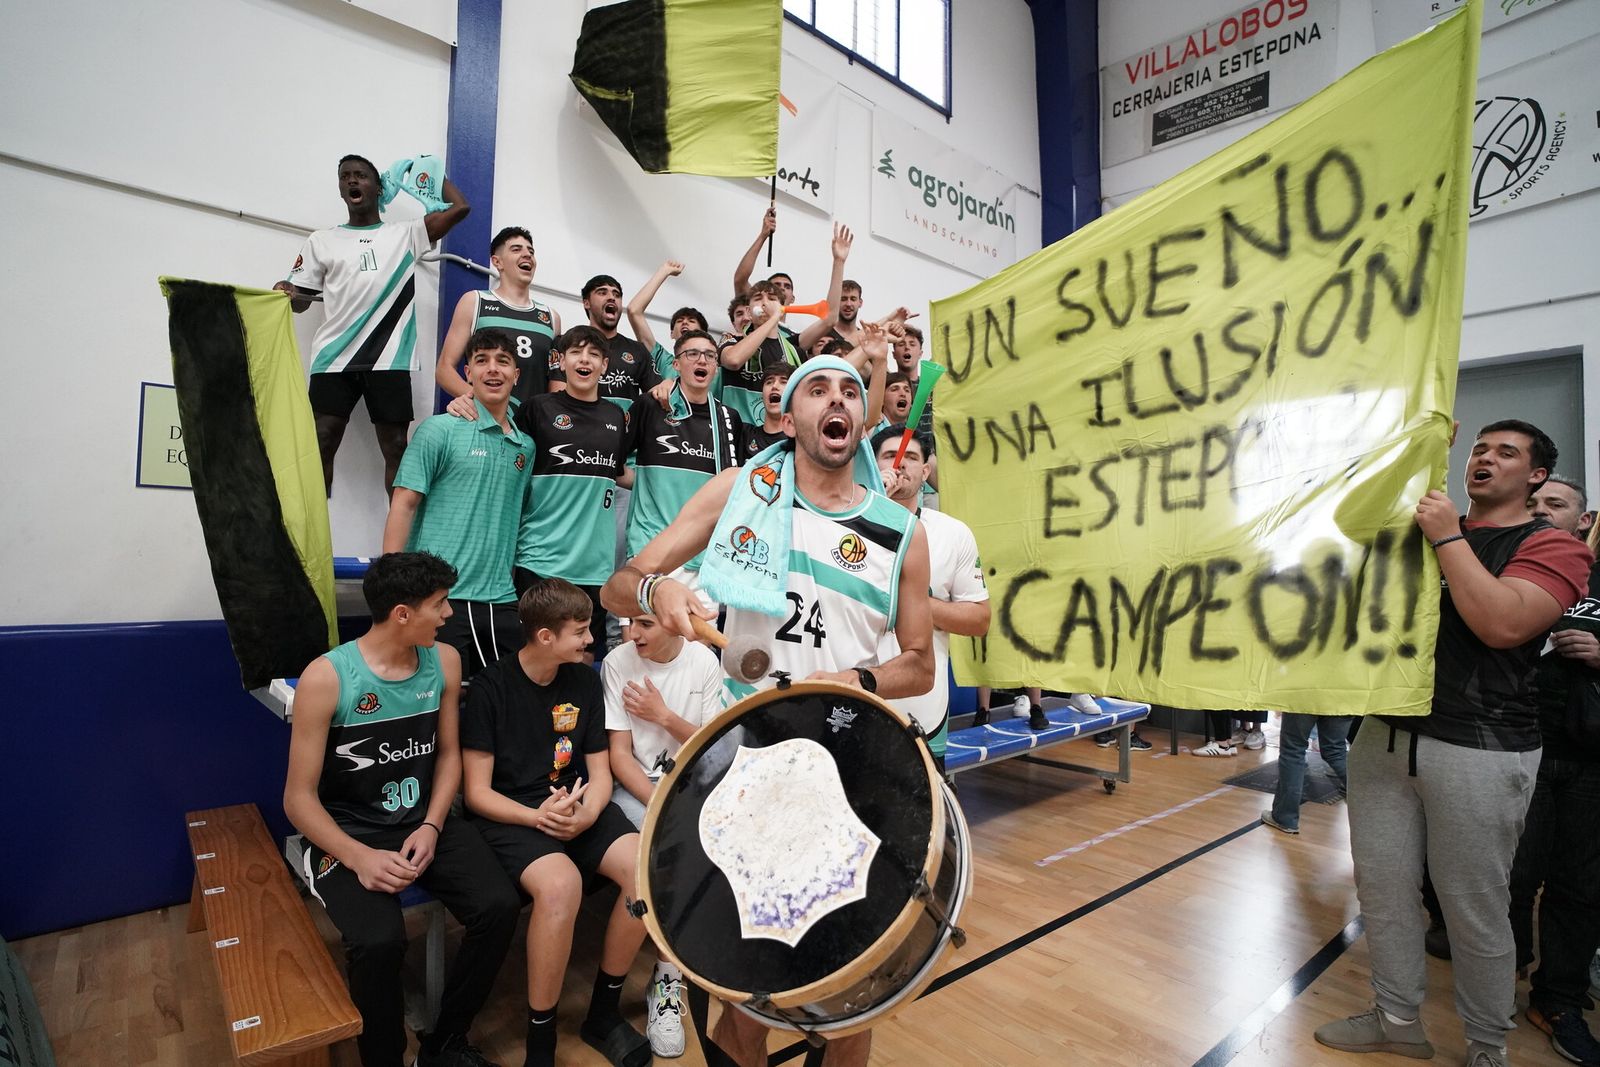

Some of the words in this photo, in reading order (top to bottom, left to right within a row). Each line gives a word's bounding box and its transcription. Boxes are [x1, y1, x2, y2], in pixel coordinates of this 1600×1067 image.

[1125, 0, 1308, 85] VILLALOBOS
[1112, 66, 1212, 118] CERRAJERIA
[1219, 22, 1321, 78] ESTEPONA
[1509, 164, 1550, 200] SPORTS
[1545, 121, 1567, 162] AGENCY
[905, 209, 998, 258] LANDSCAPING
[516, 335, 533, 359] 8
[943, 295, 1019, 384] UN
[943, 401, 1057, 465] UNA
[1080, 217, 1435, 429] ILUSIÓN
[603, 488, 614, 510] 6
[714, 542, 778, 580] Estepona
[833, 550, 865, 570] ESTEPONA
[775, 591, 827, 649] 24
[381, 776, 420, 812] 30
